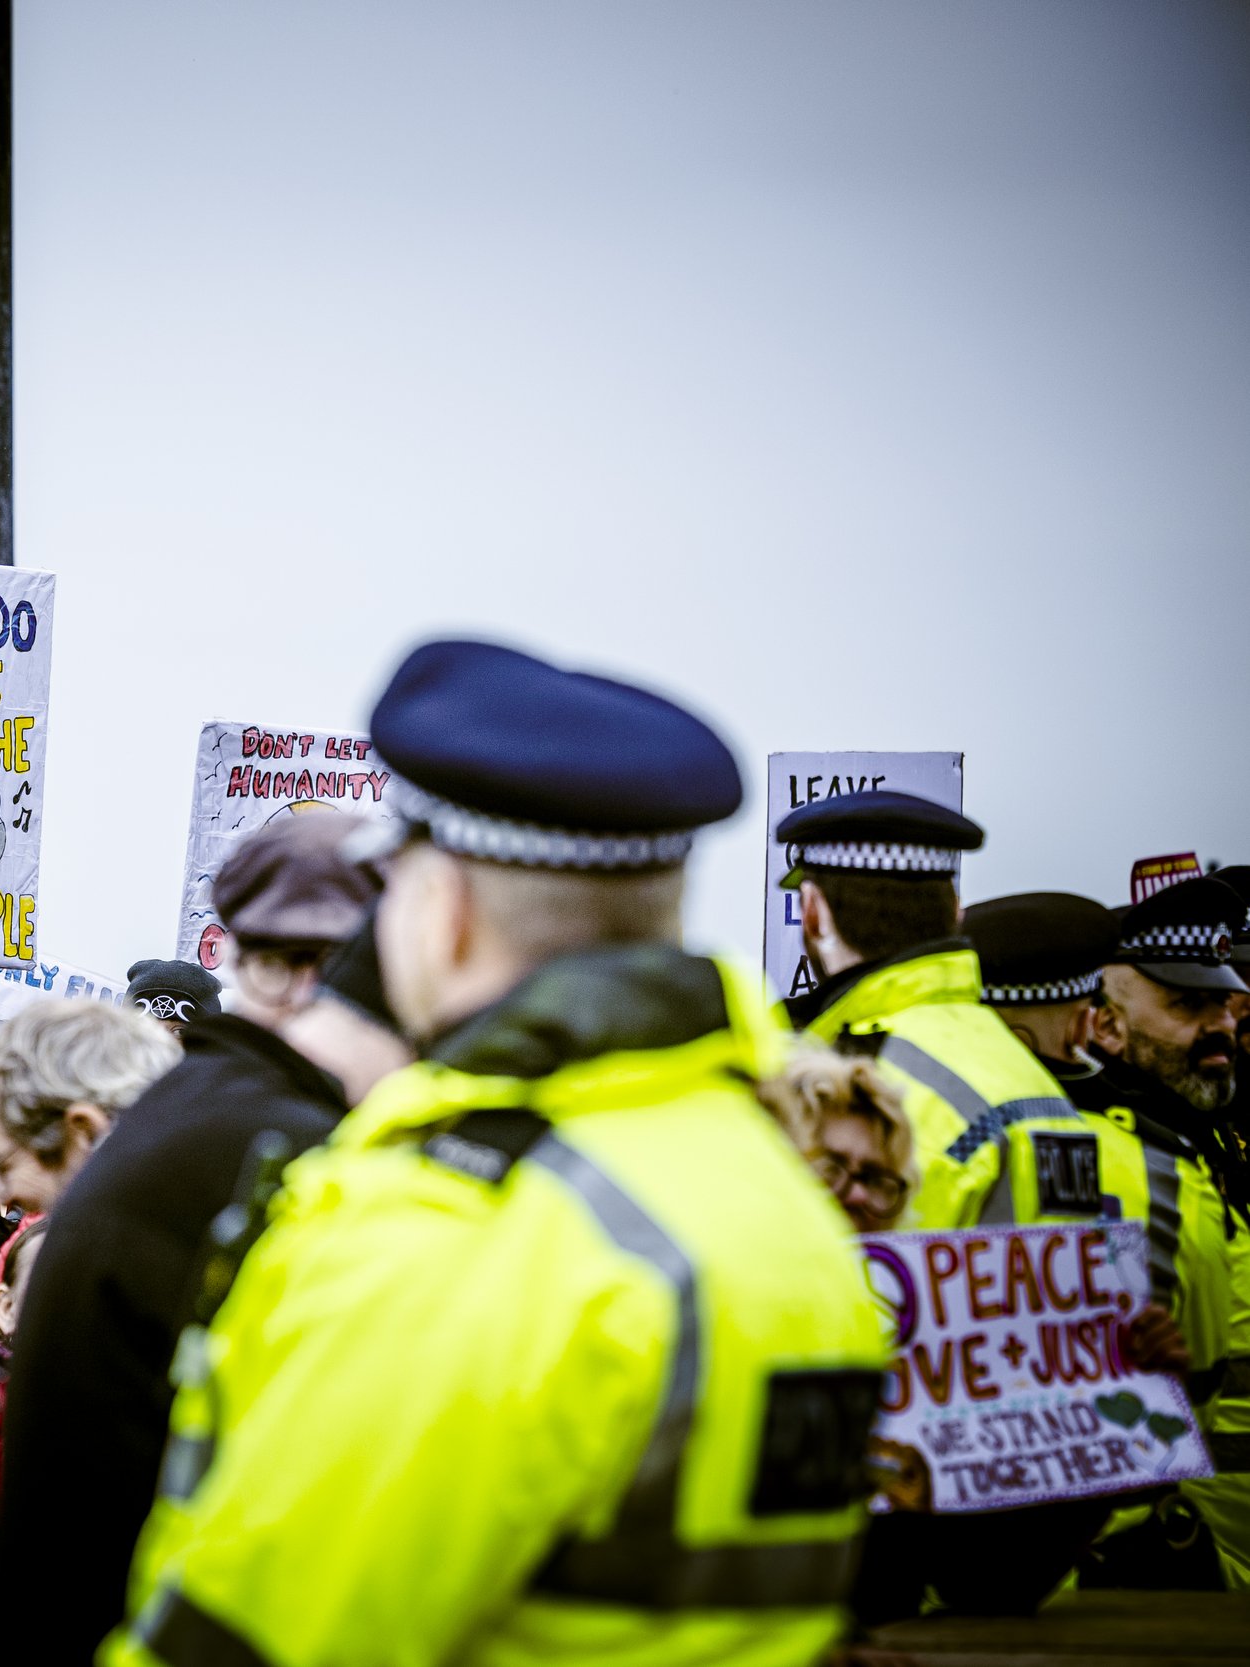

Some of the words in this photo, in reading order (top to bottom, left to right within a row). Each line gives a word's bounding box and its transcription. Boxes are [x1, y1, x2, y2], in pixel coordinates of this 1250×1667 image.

[242, 726, 314, 759] DON'T
[325, 738, 372, 760] LET
[227, 765, 391, 801] HUMANITY
[881, 1333, 1001, 1412] OVE
[979, 1402, 1100, 1451] STAND
[940, 1439, 1136, 1501] TOGETHER
